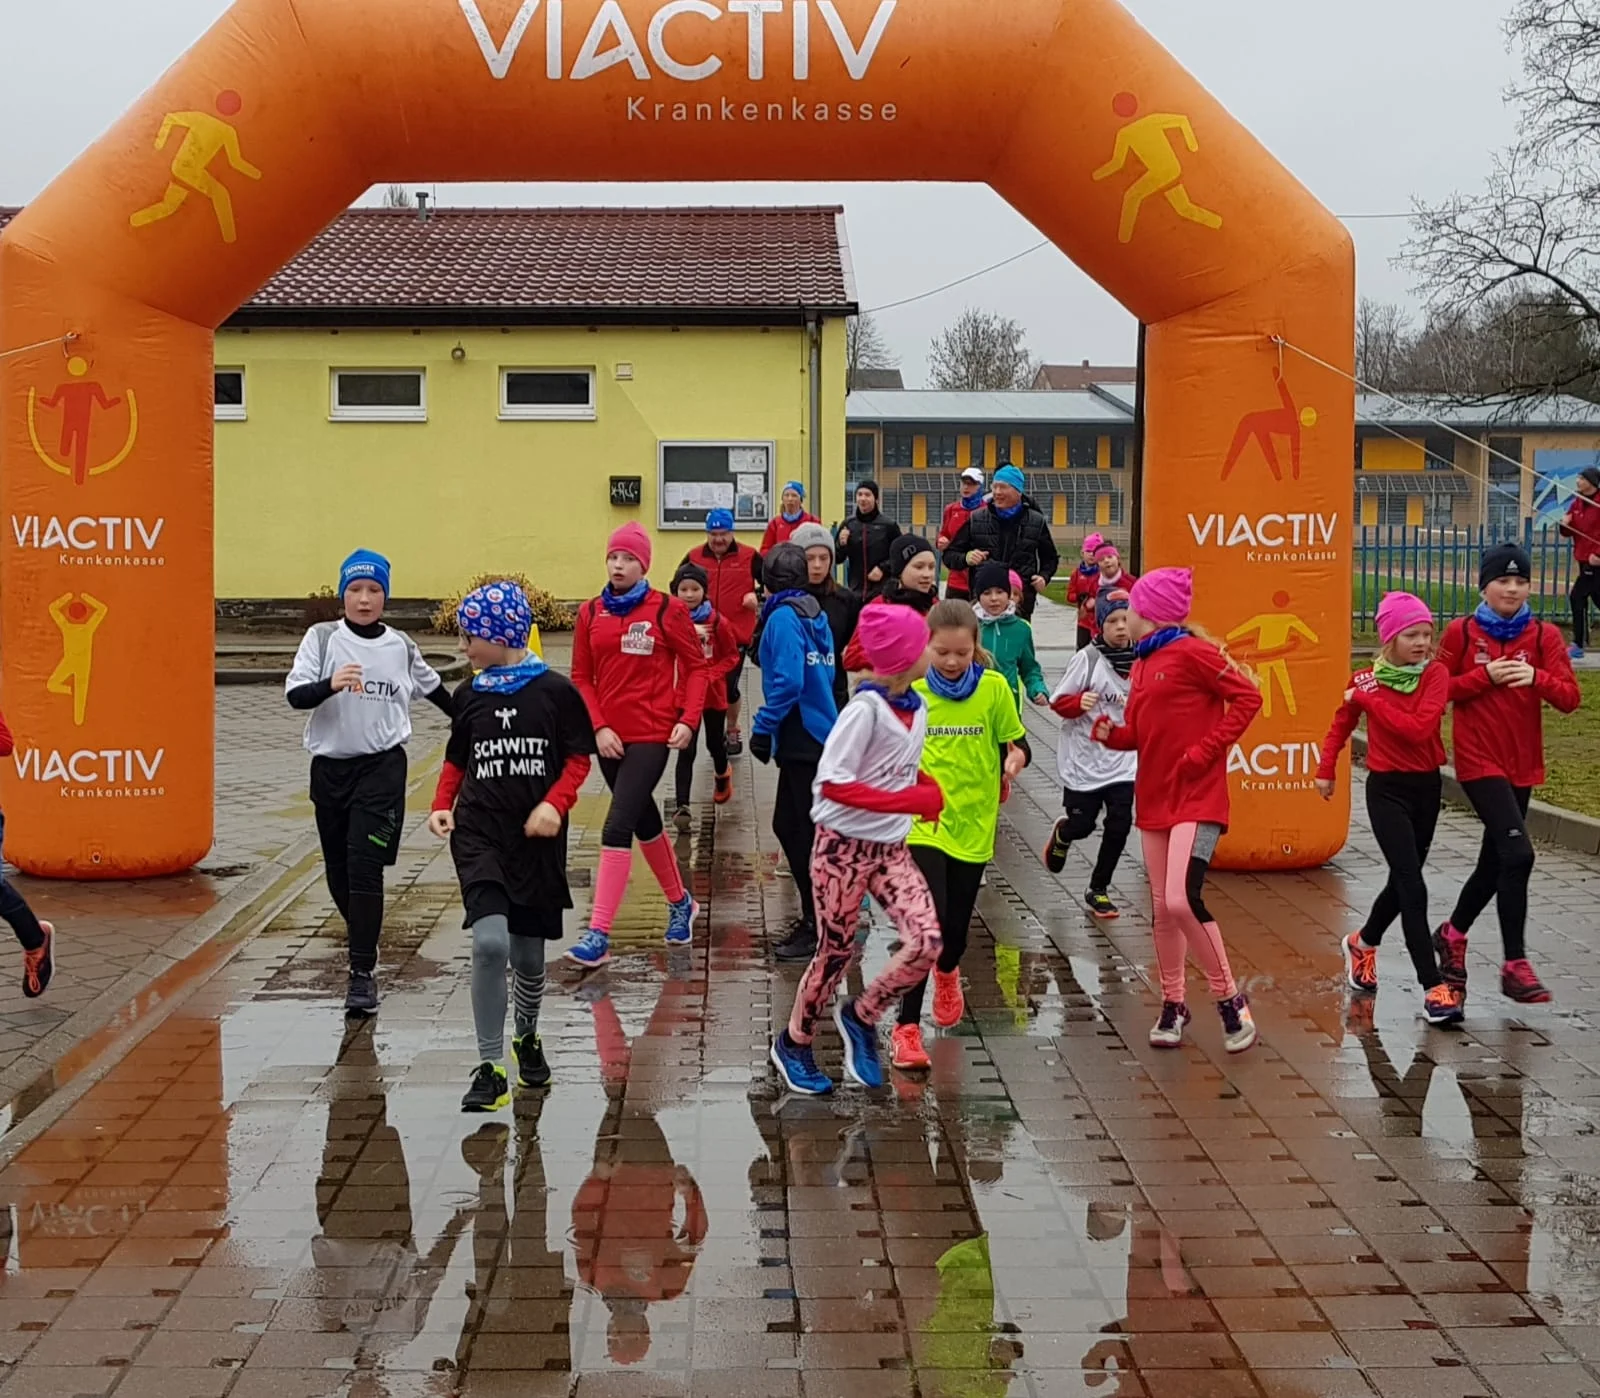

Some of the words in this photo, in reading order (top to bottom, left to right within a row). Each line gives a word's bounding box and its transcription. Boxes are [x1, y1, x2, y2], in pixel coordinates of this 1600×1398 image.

[458, 0, 897, 81] VIACTIV
[626, 97, 898, 121] Krankenkasse
[12, 514, 164, 550] VIACTIV
[1187, 512, 1338, 547] VIACTIV
[59, 554, 165, 566] Krankenkasse
[1247, 550, 1337, 562] Krankenkasse
[927, 726, 984, 736] EURAWASSER
[13, 747, 164, 783] VIACTIV
[476, 759, 504, 779] MIT
[509, 758, 546, 776] MIR!
[61, 786, 165, 798] Krankenkasse
